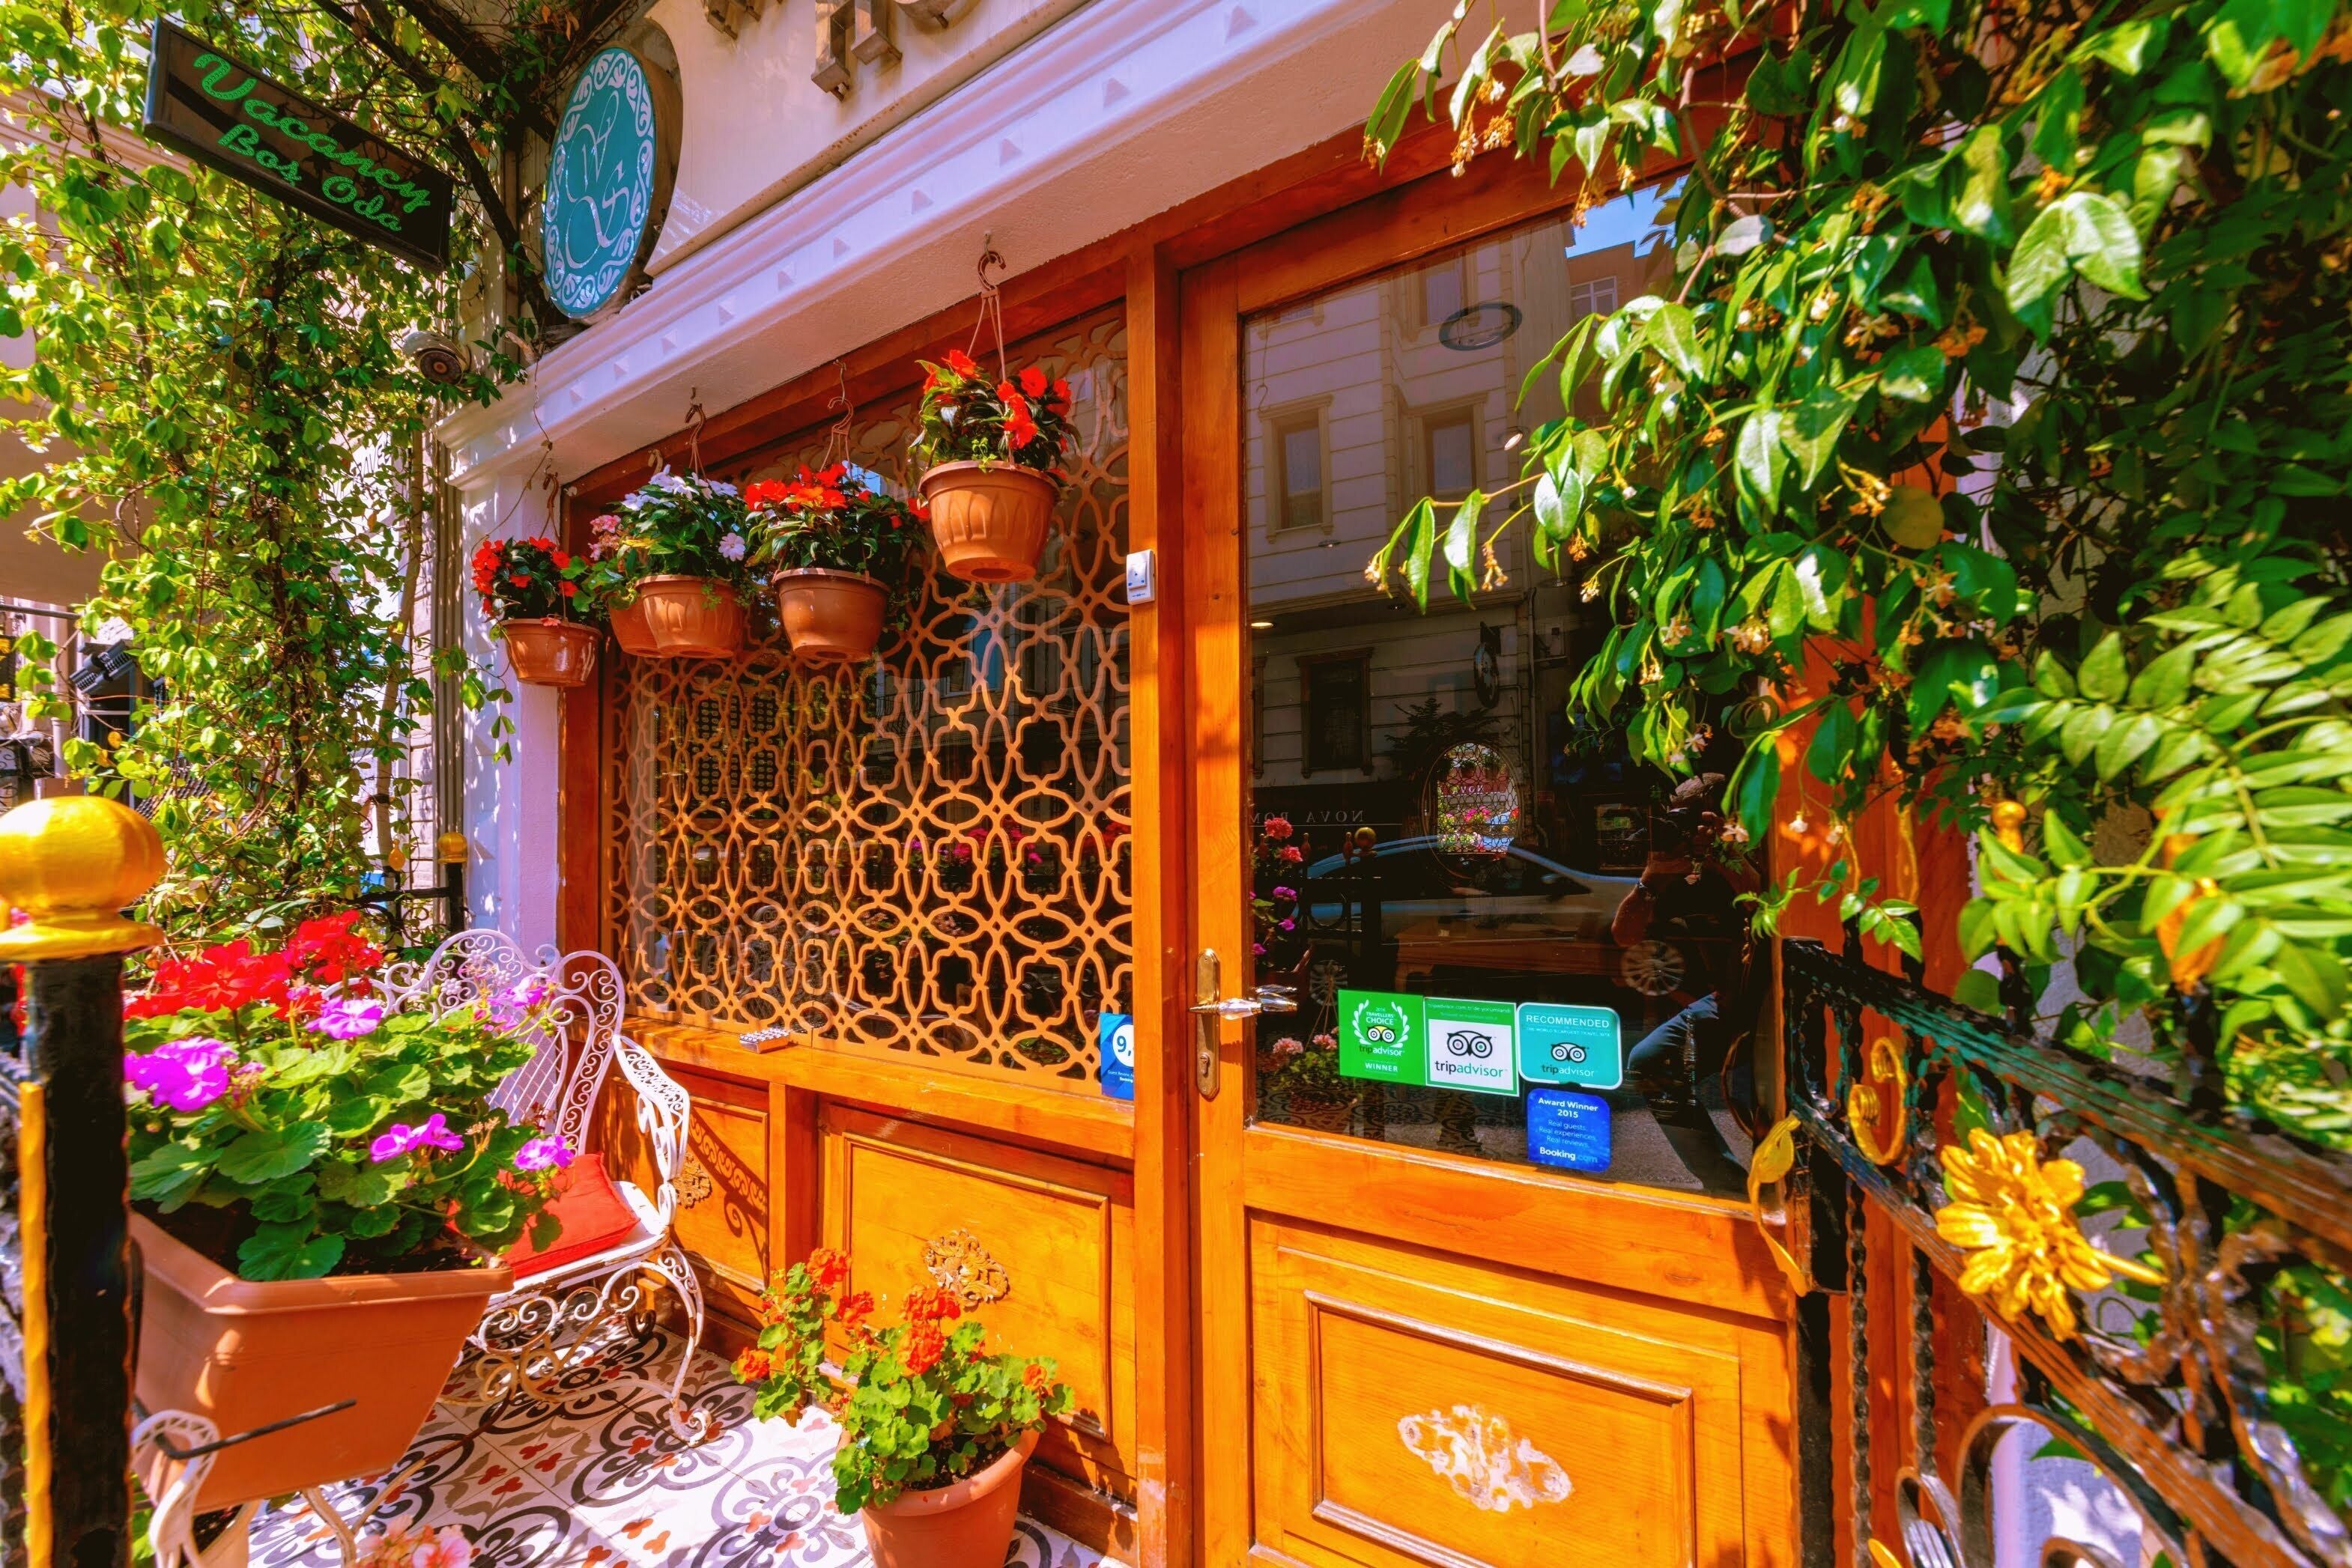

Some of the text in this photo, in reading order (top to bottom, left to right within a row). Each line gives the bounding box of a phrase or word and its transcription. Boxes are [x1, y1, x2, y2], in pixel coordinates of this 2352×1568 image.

[193, 53, 431, 213] Vacancy
[321, 176, 402, 232] Oda
[1366, 1017, 1394, 1025] CHOICE
[1526, 1015, 1610, 1028] RECOMMENDED
[1116, 1035, 1133, 1057] 9,
[1359, 1045, 1402, 1057] tripadvisor
[1365, 1062, 1398, 1072] WINNER
[1434, 1060, 1503, 1078] tripadvisor
[1541, 1063, 1595, 1077] tripadvisor
[1538, 1097, 1598, 1112] Award Winner
[1557, 1109, 1579, 1119] 2015
[1548, 1119, 1563, 1127] Real
[1539, 1125, 1554, 1134] Real
[1546, 1134, 1561, 1144] Real
